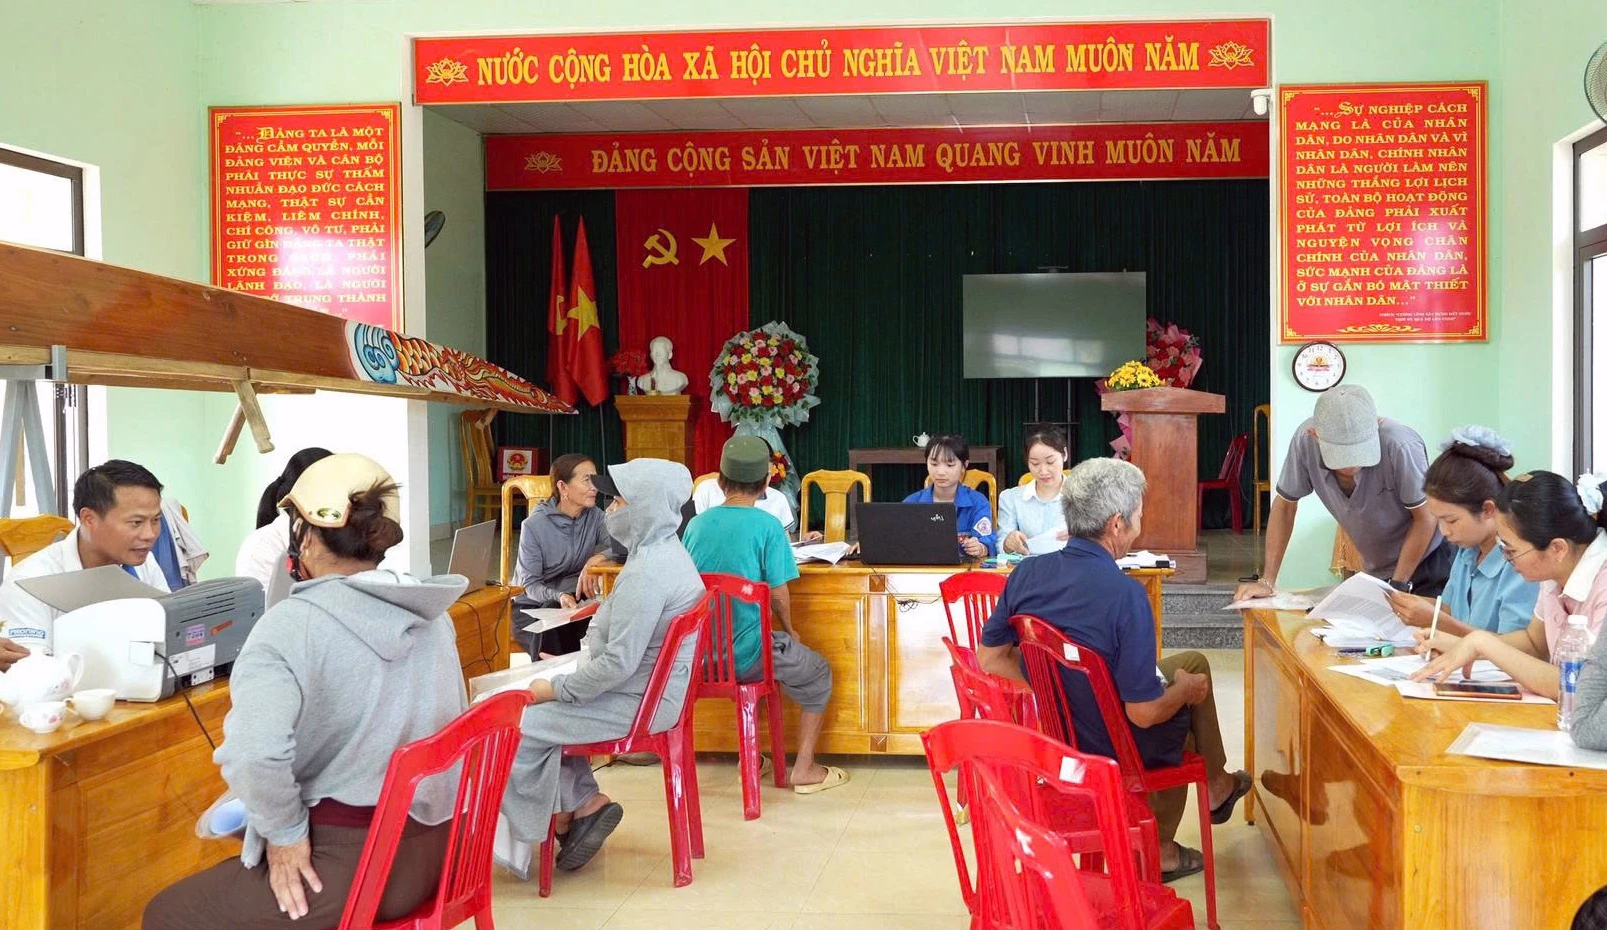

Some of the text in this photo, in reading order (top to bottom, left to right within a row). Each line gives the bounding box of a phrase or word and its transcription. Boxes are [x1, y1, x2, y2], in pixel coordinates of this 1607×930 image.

[477, 35, 1200, 89] NƯỚC CỘNG HÒA XÃ HỘI CHỦ NGHĨA VIỆT NAM MUÔN NĂM
[1369, 104, 1423, 115] NGHIỆP
[1428, 102, 1467, 113] CÁCH
[1296, 116, 1467, 131] MẠNG LÀ CỦA NHÂN
[331, 127, 348, 137] LÀ
[352, 127, 383, 138] MỘT
[1333, 136, 1352, 144] DO
[1355, 134, 1394, 144] NHÂN
[1398, 132, 1427, 143] DÂN
[1431, 132, 1450, 143] VÀ
[1452, 132, 1467, 142] VÌ
[225, 143, 263, 153] ĐẢNG
[267, 141, 297, 152] CẦM
[357, 138, 384, 150] MỖI
[591, 132, 1241, 177] ĐẢNG CỘNG SẢN VIỆT NAM QUANG VINH MUÔN NĂM
[1296, 150, 1335, 159] NHÂN
[1378, 148, 1423, 158] CHÍNH
[1428, 147, 1467, 157] NHÂN
[226, 155, 383, 167] ĐẢNG VIÊN VÀ CÁN BỘ
[1296, 161, 1467, 174] DÂN LÀ NGƯỜI LÀM NÊN
[226, 166, 384, 181] PHẢI THỰC SỰ THẤM
[226, 182, 384, 194] NHUẦN ĐẠO ĐỨC CÁCH
[1296, 174, 1467, 189] NHỮNG THẮNG LỢI LỊCH
[281, 198, 318, 208] THẬT
[329, 197, 346, 207] SỰ
[356, 193, 384, 205] CẦN
[1323, 193, 1359, 203] TOÀN
[1363, 192, 1382, 204] BỘ
[1386, 192, 1425, 203] HOẠT
[1428, 191, 1467, 202] ĐỘNG
[283, 211, 320, 220] LIÊM
[1296, 203, 1467, 219] CỦA ĐẢNG PHẢI XUẤT
[226, 225, 251, 235] CHÍ
[302, 225, 320, 234] VÔ
[352, 222, 385, 233] PHẢI
[1296, 220, 1467, 233] PHÁT TỪ LỢI ÍCH VÀ
[227, 238, 251, 249] GIỮ
[255, 239, 279, 248] GÌN
[347, 238, 385, 249] THẬT
[1297, 234, 1467, 248] NGUYỆN VỌNG CHÂN
[227, 254, 278, 262] TRONG
[348, 249, 385, 261] PHẢI
[1297, 251, 1342, 263] CHÍNH
[1350, 250, 1379, 262] CỦA
[1387, 250, 1425, 261] NHÂN
[227, 266, 266, 277] XỨNG
[342, 264, 386, 275] NGƯỜI
[1297, 263, 1468, 277] SỨC MẠNH CỦA ĐẢNG LÀ
[342, 279, 386, 289] NGƯỜI
[1297, 276, 1468, 292] Ở SỰ GẮN BÓ MẬT THIẾT
[339, 291, 386, 302] THÀNH
[1297, 295, 1321, 306] VỚI
[1324, 295, 1363, 305] NHÂN
